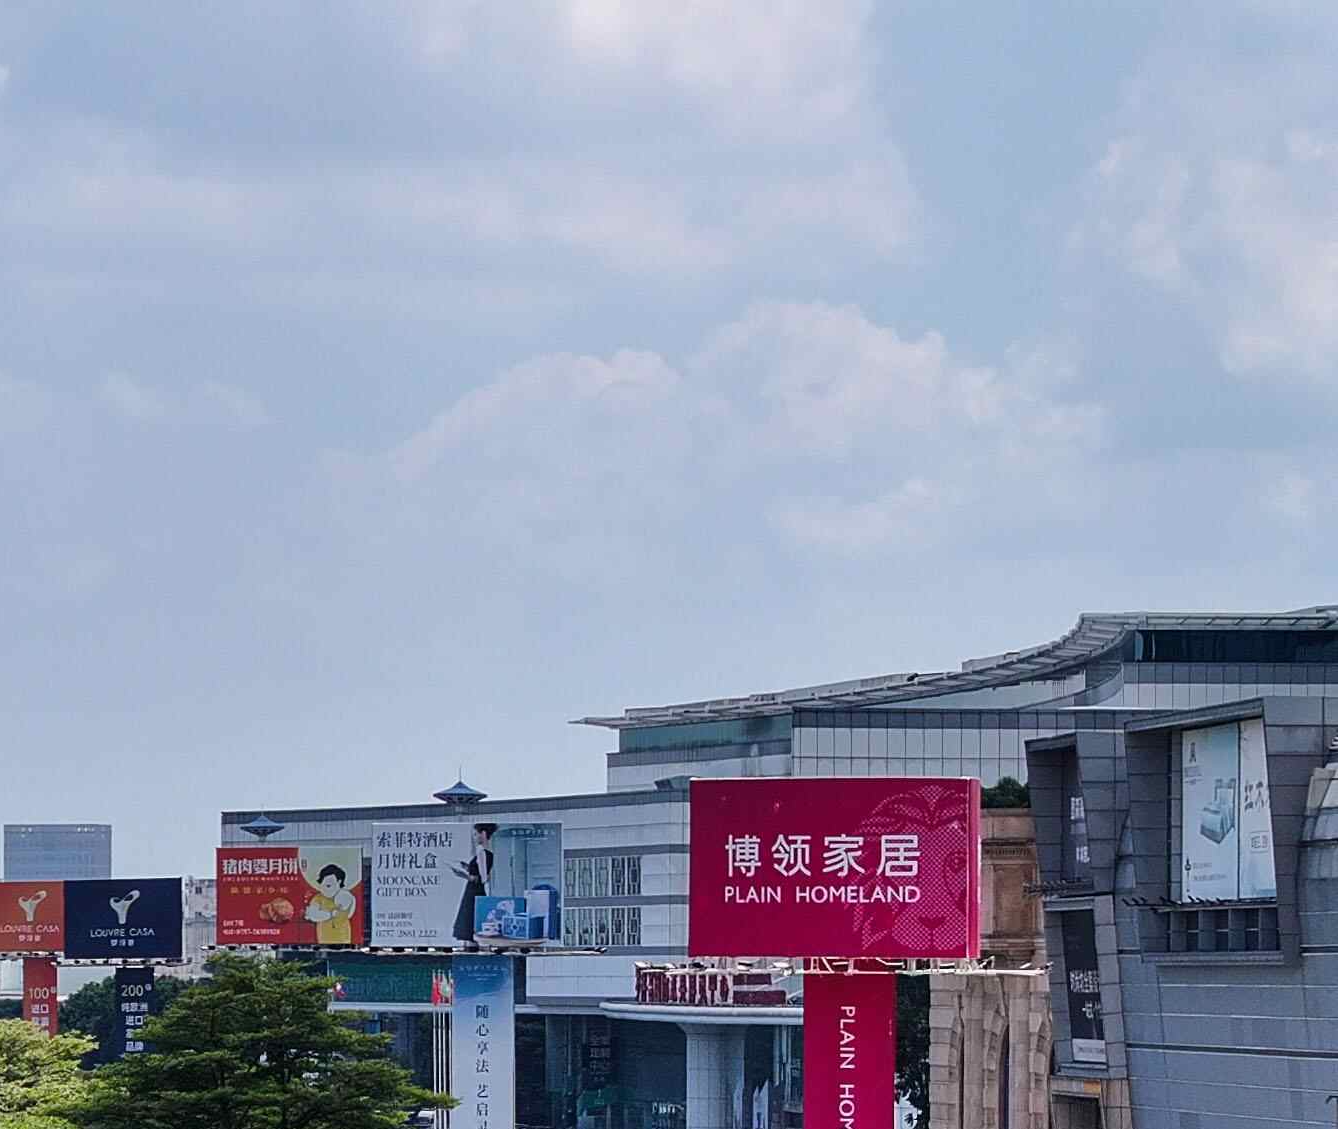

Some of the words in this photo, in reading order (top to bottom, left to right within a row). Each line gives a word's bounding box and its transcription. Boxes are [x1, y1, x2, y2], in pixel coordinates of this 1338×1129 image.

[377, 832, 452, 849] 索菲特酒店
[377, 852, 437, 869] 月饼礼盒
[724, 833, 921, 878] 博领家居
[376, 875, 441, 886] MOONCAKE
[376, 887, 402, 897] GIFT
[404, 887, 428, 897] BOX
[724, 886, 781, 904] PLAIN
[795, 886, 921, 904] HOMELAND
[36, 925, 60, 933] CASA
[90, 928, 125, 938] LOUVRE
[129, 927, 155, 937] CASA
[840, 1006, 856, 1069] PLAIN
